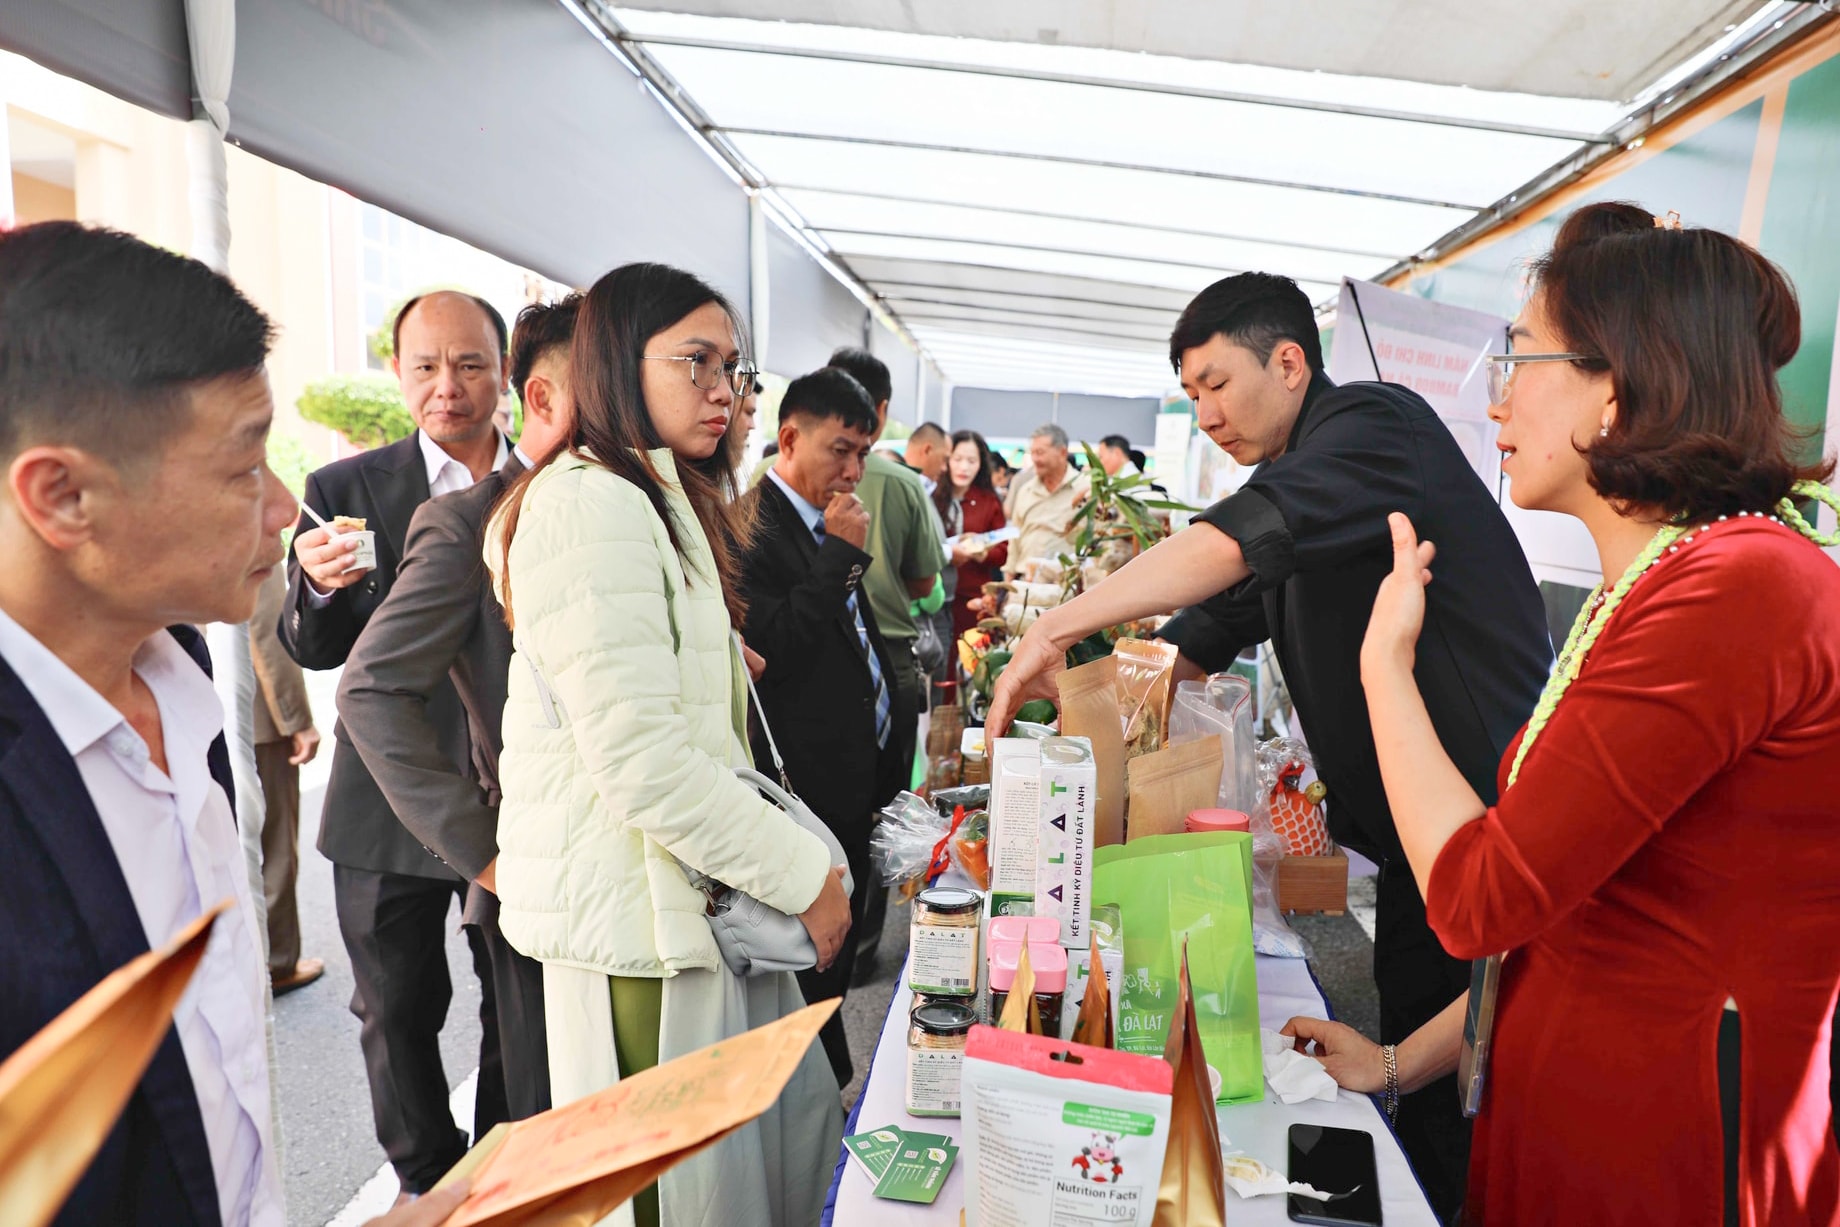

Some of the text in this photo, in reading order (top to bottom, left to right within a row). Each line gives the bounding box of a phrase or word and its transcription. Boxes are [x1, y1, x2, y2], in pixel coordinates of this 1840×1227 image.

[1072, 893, 1081, 918] TINH
[1123, 1012, 1142, 1032] ĐÀ
[1056, 1181, 1138, 1200] Nutrition Facts
[1104, 1204, 1127, 1217] 100
